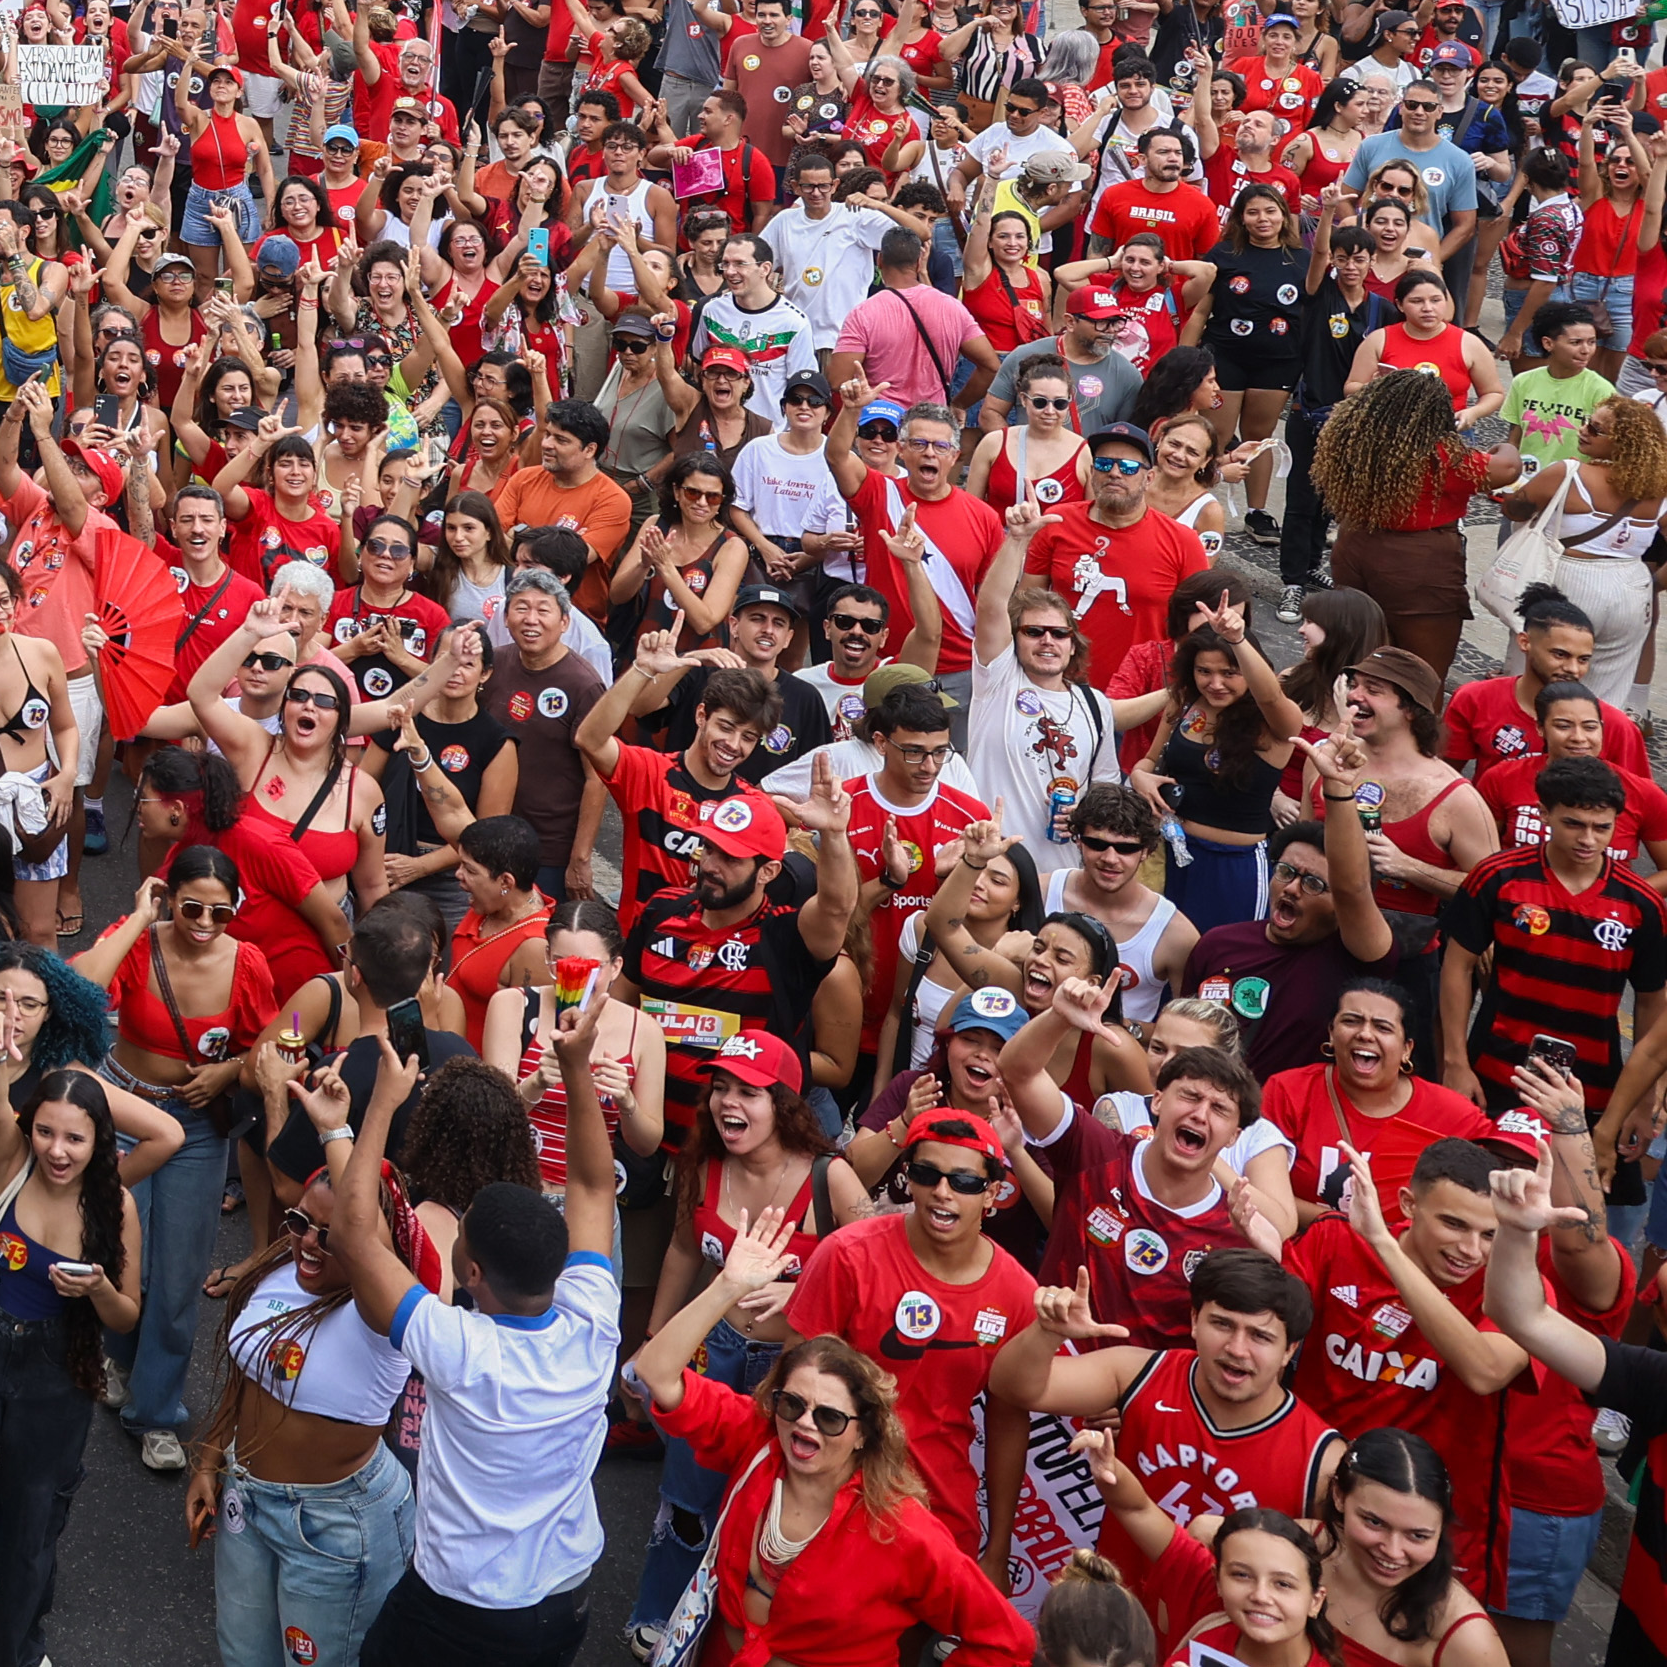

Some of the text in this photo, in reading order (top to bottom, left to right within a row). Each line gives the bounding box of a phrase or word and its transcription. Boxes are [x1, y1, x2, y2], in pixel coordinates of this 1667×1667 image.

[18, 61, 80, 83] ESTUDANTE
[1130, 206, 1177, 223] BRASIL
[762, 476, 816, 491] Make America
[774, 486, 802, 497] Latina
[697, 1016, 717, 1033] 13
[1325, 1332, 1439, 1392] CAIXA
[1137, 1443, 1258, 1511] RAPTOR
